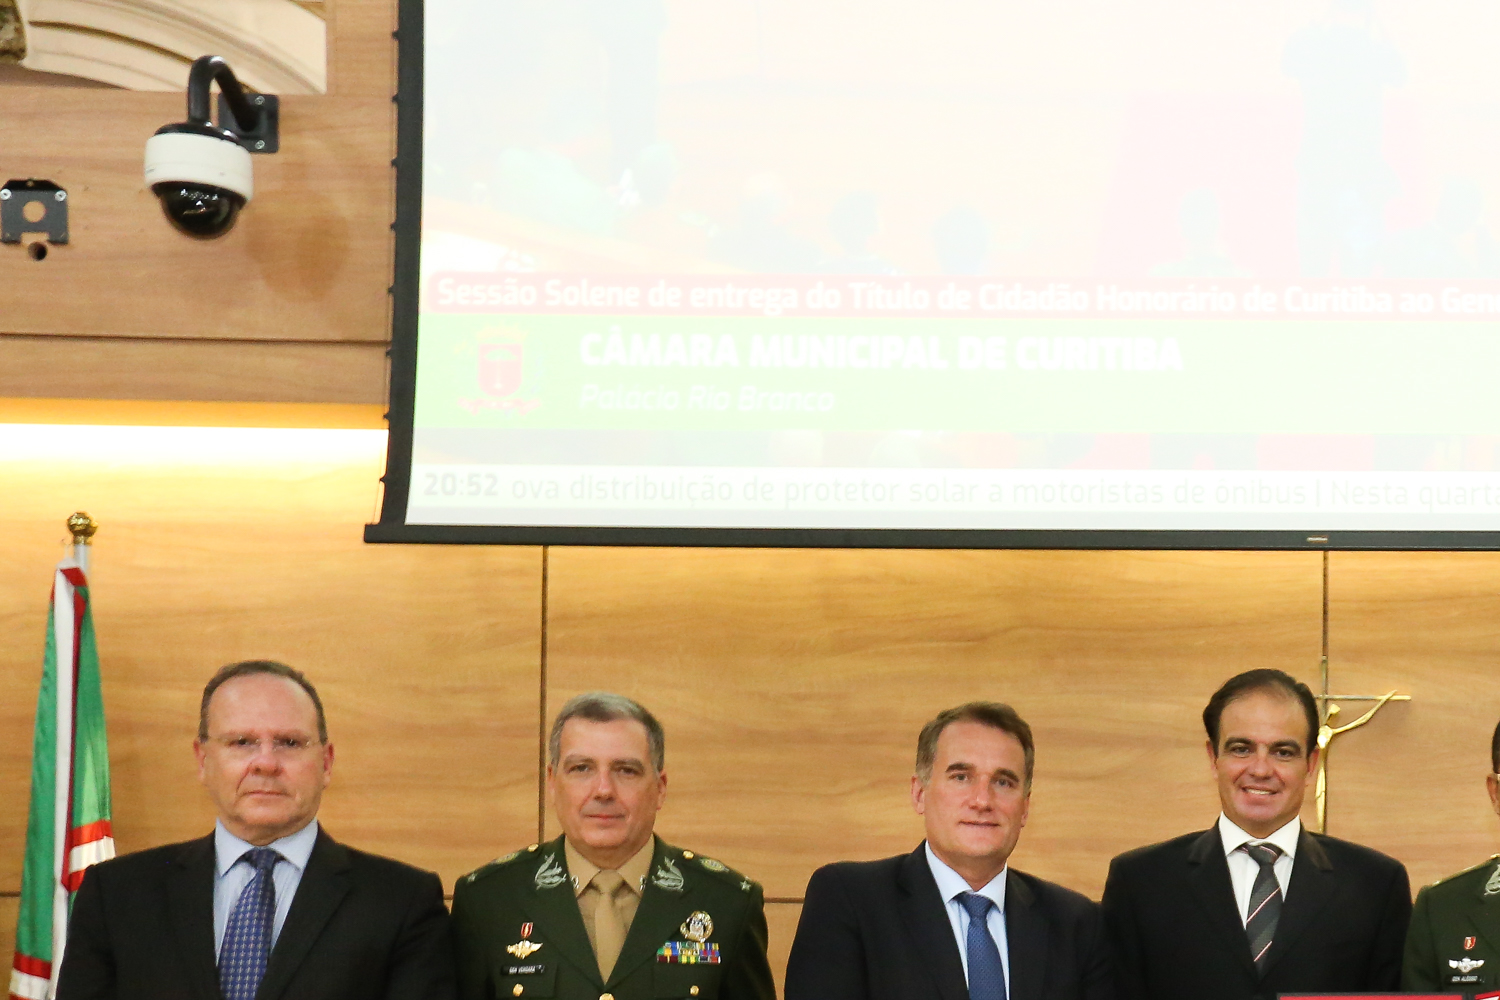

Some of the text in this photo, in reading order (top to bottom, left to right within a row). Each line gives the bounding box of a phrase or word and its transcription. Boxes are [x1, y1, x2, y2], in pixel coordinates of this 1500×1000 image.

[437, 278, 537, 305] Sessão
[545, 279, 640, 306] Solene
[648, 280, 682, 307] de
[690, 283, 798, 316] entrega
[806, 282, 841, 309] do
[849, 282, 930, 310] Título
[937, 282, 971, 310] de
[979, 283, 1088, 312] Cidadão
[1096, 284, 1236, 313] Honorário
[1244, 285, 1277, 313] de
[1284, 286, 1393, 313] Curitiba
[1400, 292, 1433, 313] ao
[579, 324, 1185, 371] CÂMARA MUNICIPAL DE CURITIBA
[578, 384, 835, 412] Palácio Rio Branco
[423, 471, 499, 498] 20:52
[569, 474, 733, 507] distribuição
[743, 476, 775, 501] de
[784, 478, 900, 509] protetor
[909, 477, 980, 503] solar
[988, 483, 1003, 503] a
[1014, 479, 1164, 505] motoristas
[1173, 478, 1206, 505] de
[1215, 478, 1307, 506] ônibus
[1331, 480, 1409, 506] Nesta
